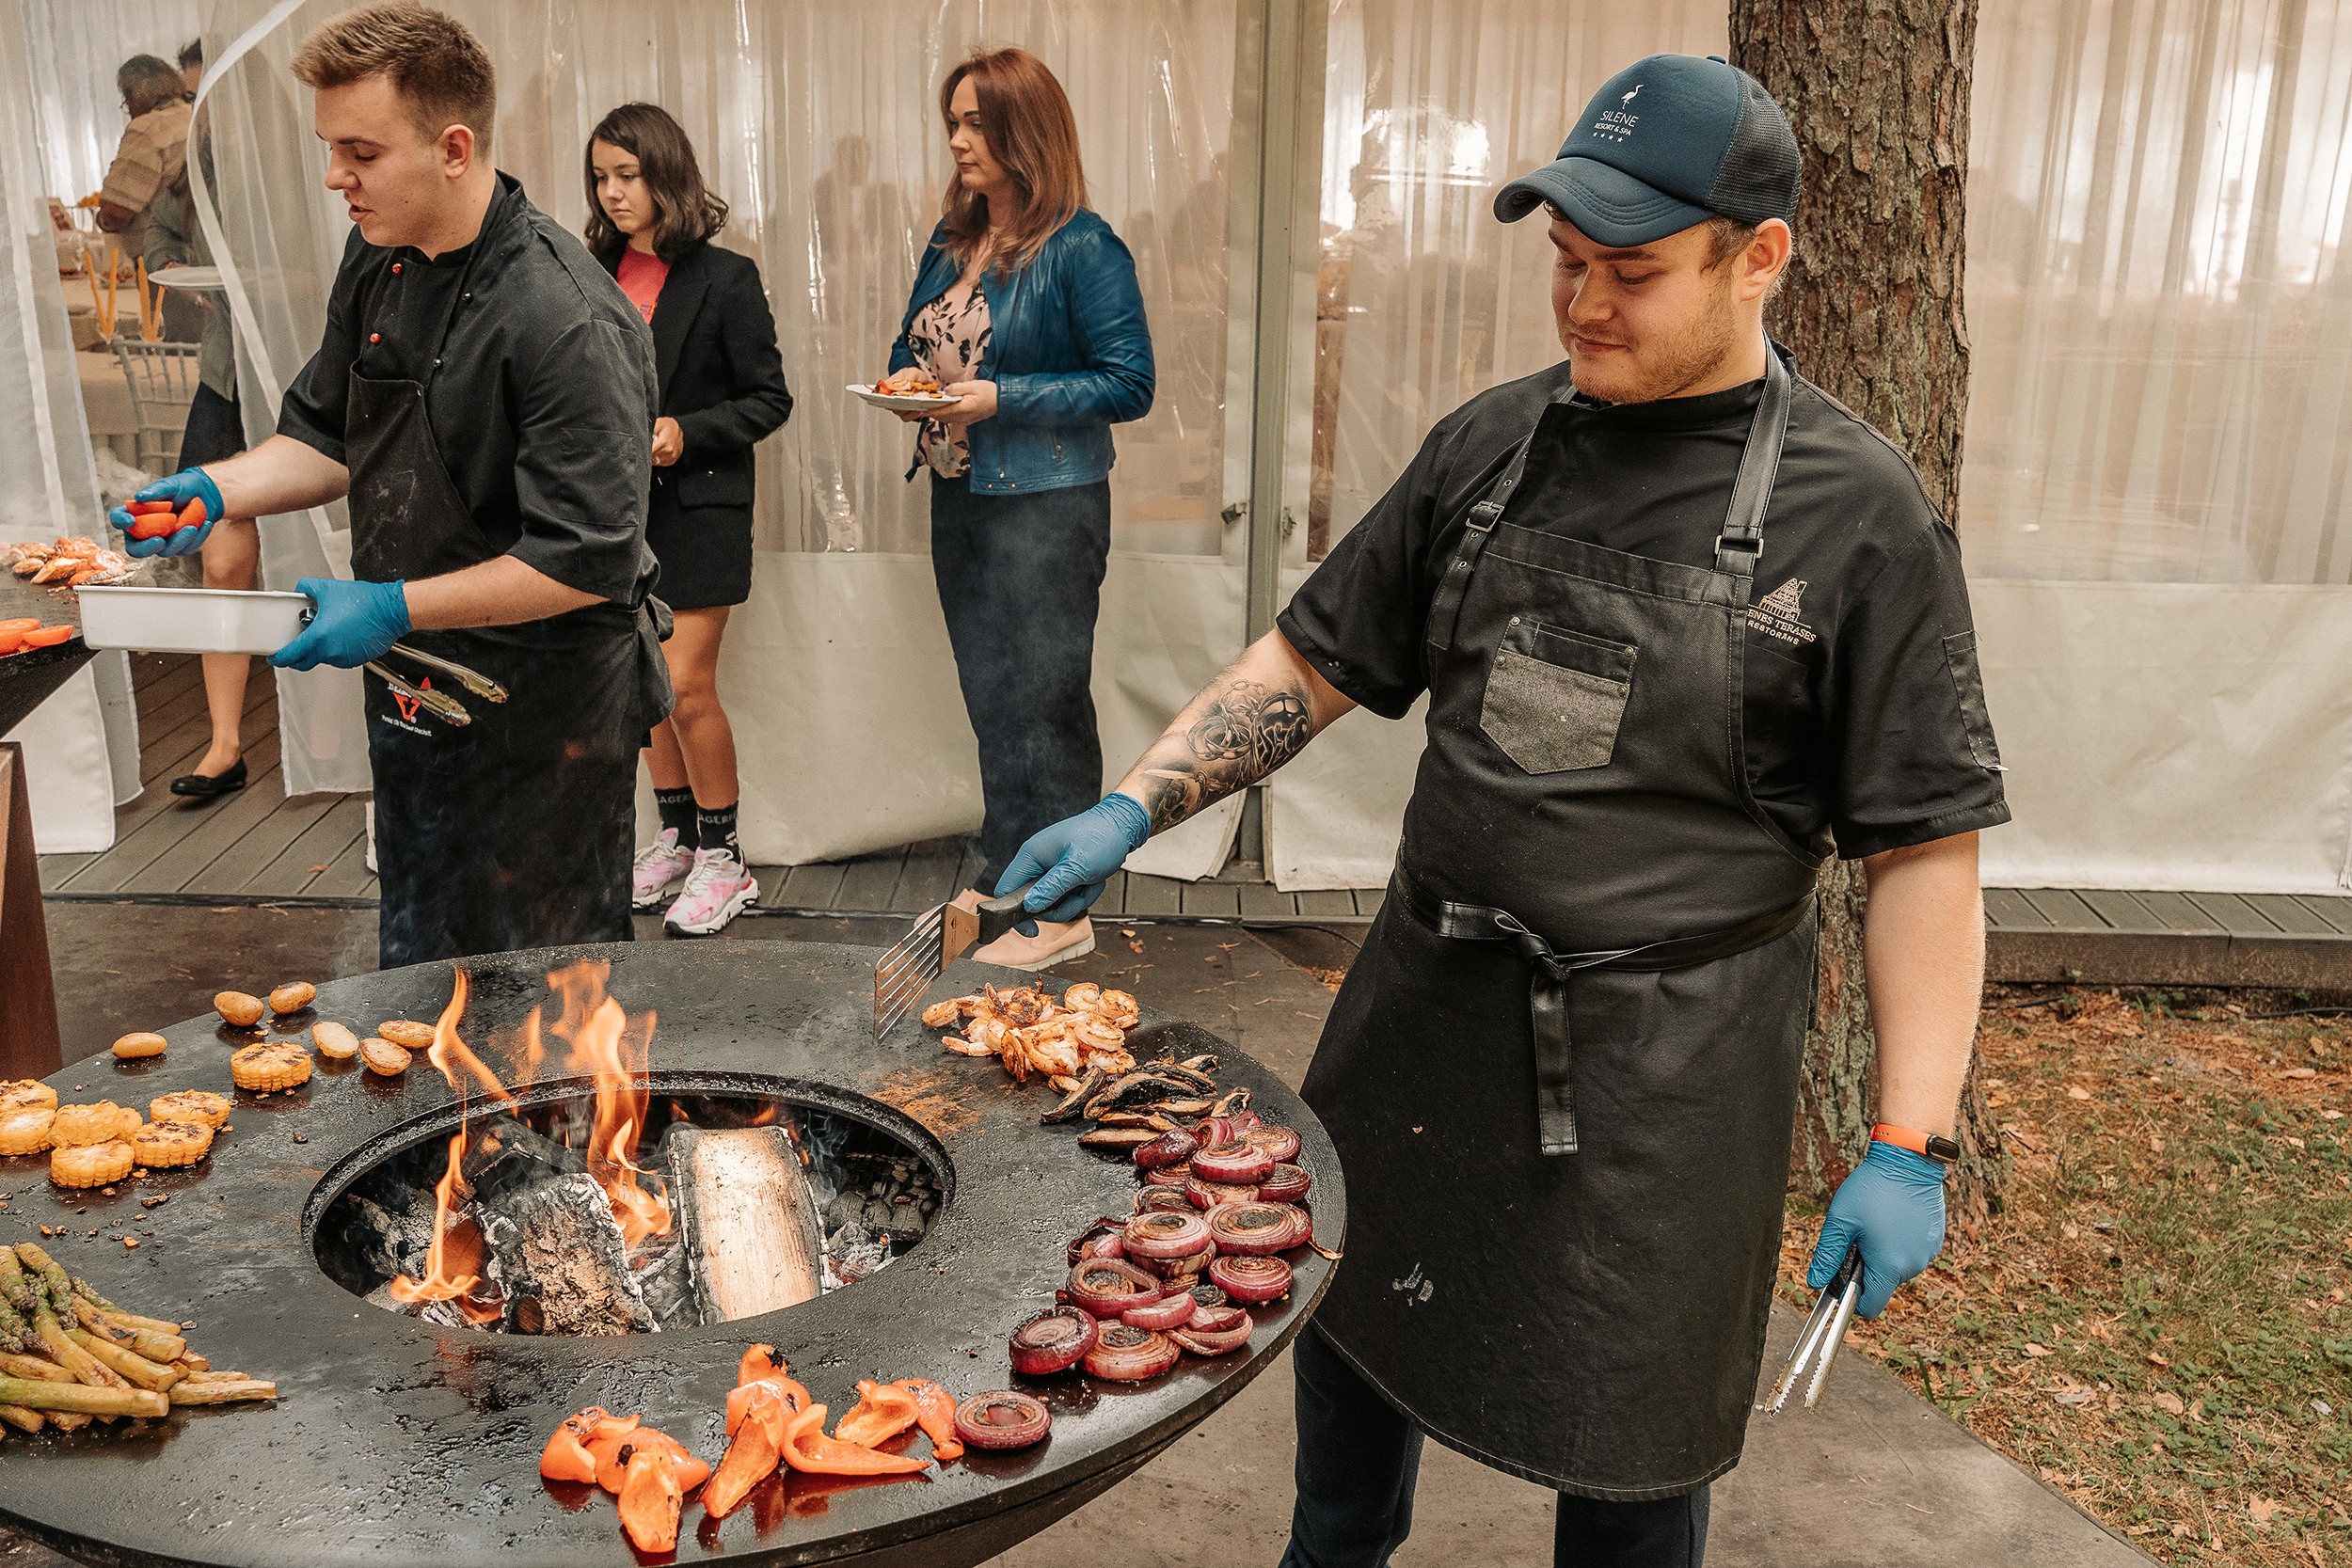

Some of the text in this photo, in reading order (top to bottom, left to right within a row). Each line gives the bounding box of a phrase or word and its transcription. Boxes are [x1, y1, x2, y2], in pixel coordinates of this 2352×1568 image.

[1599, 110, 1640, 128] SILENE
[1594, 122, 1615, 132] RESORT
[1619, 127, 1631, 136] SPA
[1747, 609, 1817, 642] ENES TERASES
